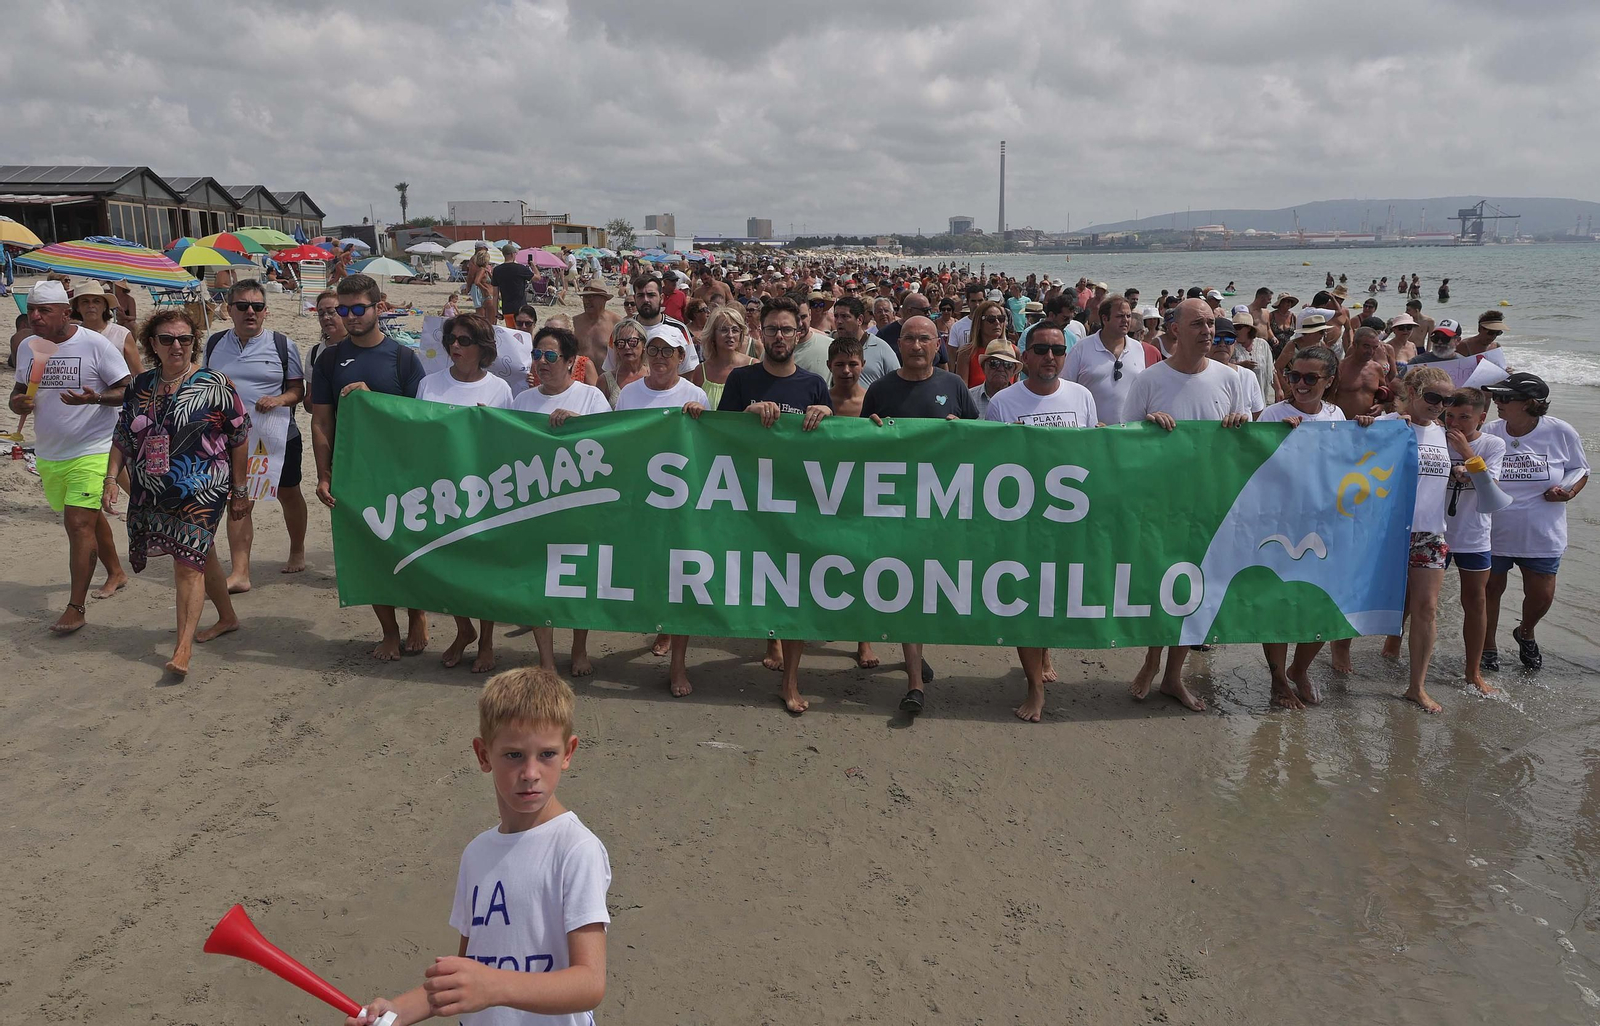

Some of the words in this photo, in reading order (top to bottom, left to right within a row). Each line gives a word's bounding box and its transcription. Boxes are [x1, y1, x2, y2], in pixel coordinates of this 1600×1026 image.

[43, 366, 78, 375] INCONCILLO
[1502, 454, 1531, 462] PLAYA
[1502, 460, 1546, 469] RINCONCILLO
[362, 438, 614, 541] VERDEMAR
[645, 452, 1091, 523] SALVEMOS
[544, 543, 635, 602] EL
[668, 548, 1205, 619] RINCONCILLO
[471, 880, 511, 926] LA
